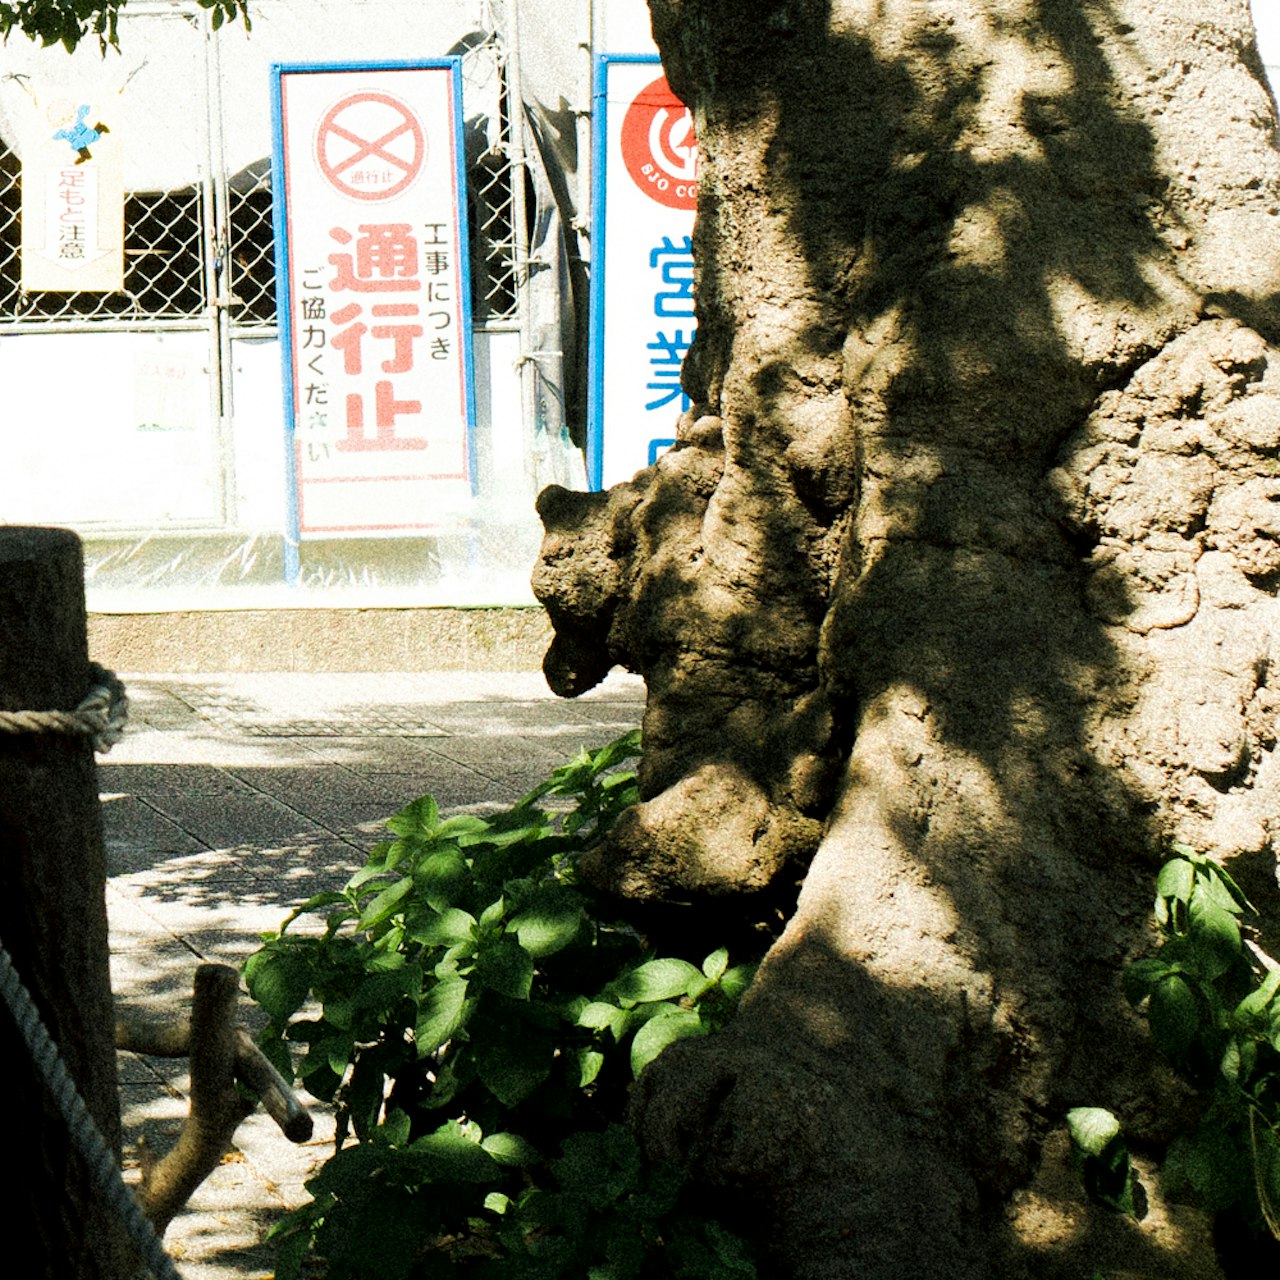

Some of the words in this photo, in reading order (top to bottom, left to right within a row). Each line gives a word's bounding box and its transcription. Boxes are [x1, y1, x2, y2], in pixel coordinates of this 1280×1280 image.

[58, 171, 86, 259] 足もと注意
[351, 170, 393, 184] 通行止
[327, 223, 428, 452] 通行止
[424, 223, 452, 361] 工事につき
[301, 266, 330, 462] ご協力ください
